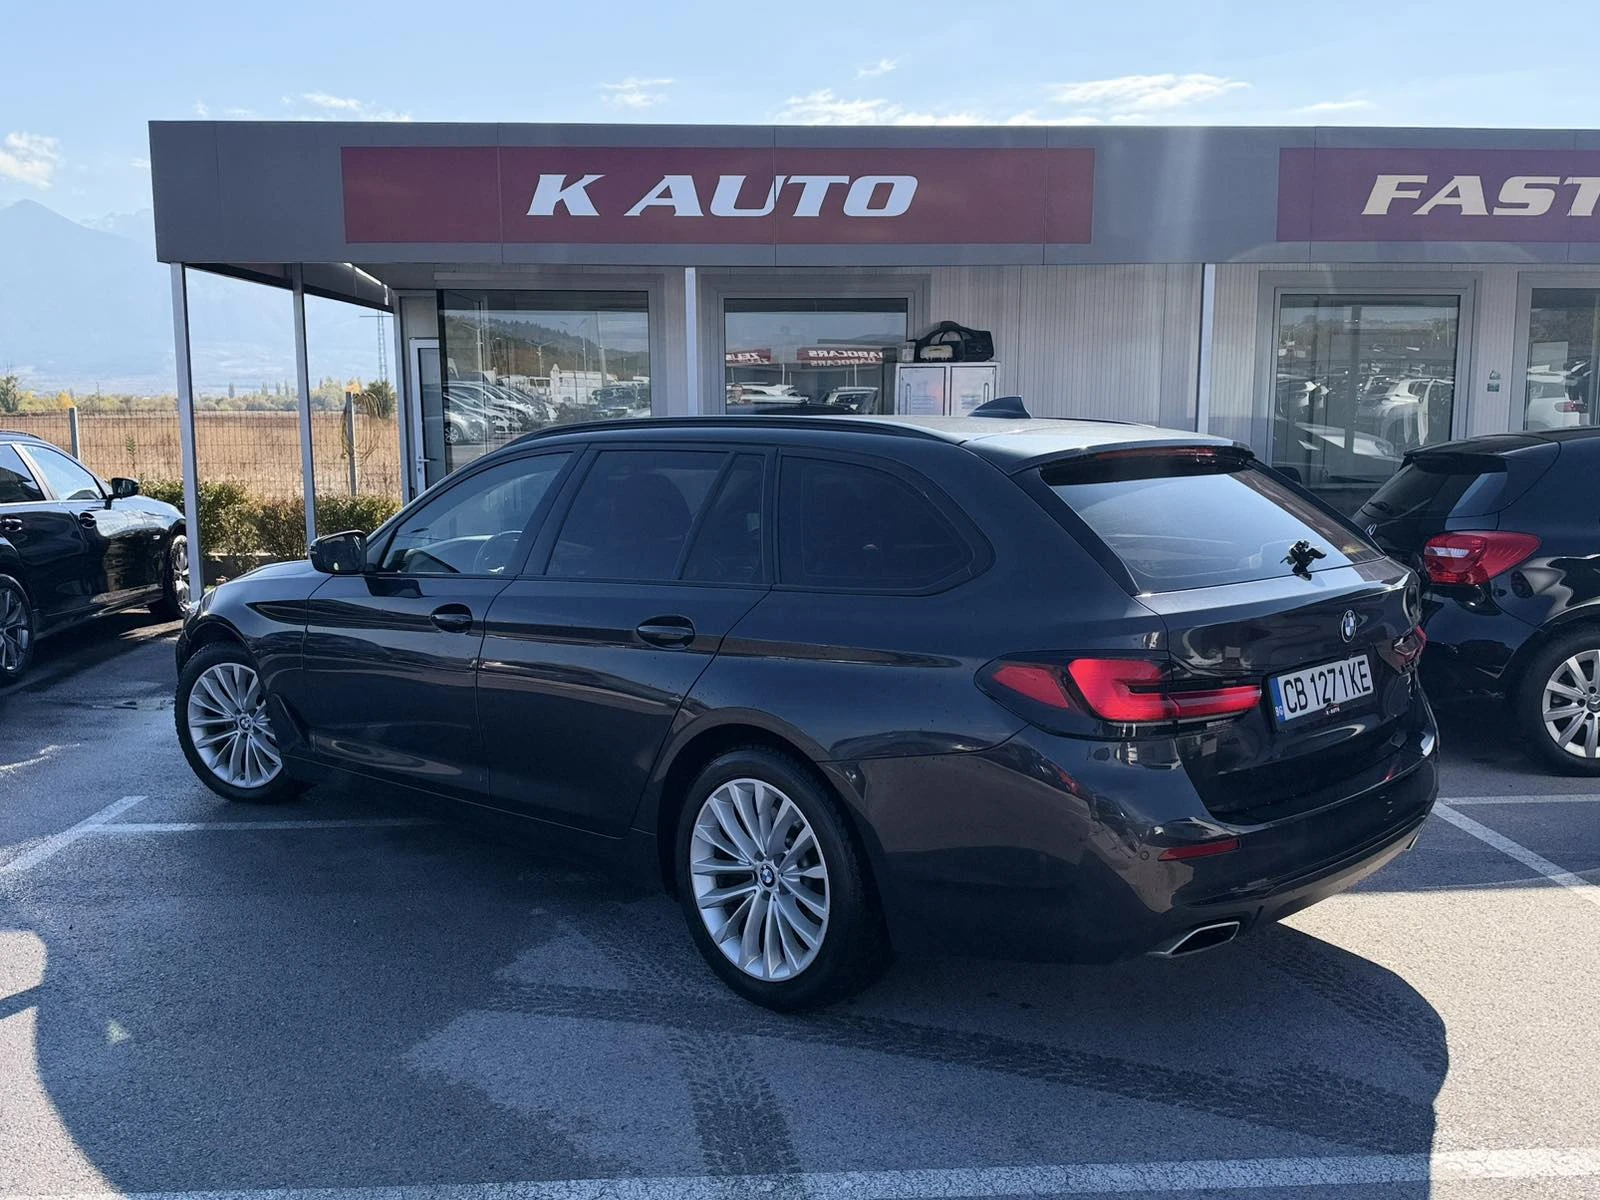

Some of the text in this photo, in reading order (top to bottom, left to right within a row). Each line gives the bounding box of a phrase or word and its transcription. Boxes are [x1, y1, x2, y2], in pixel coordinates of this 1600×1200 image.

[525, 174, 918, 217] K AUTO
[1361, 174, 1600, 216] FAST
[1283, 660, 1370, 713] CB 1271 KE
